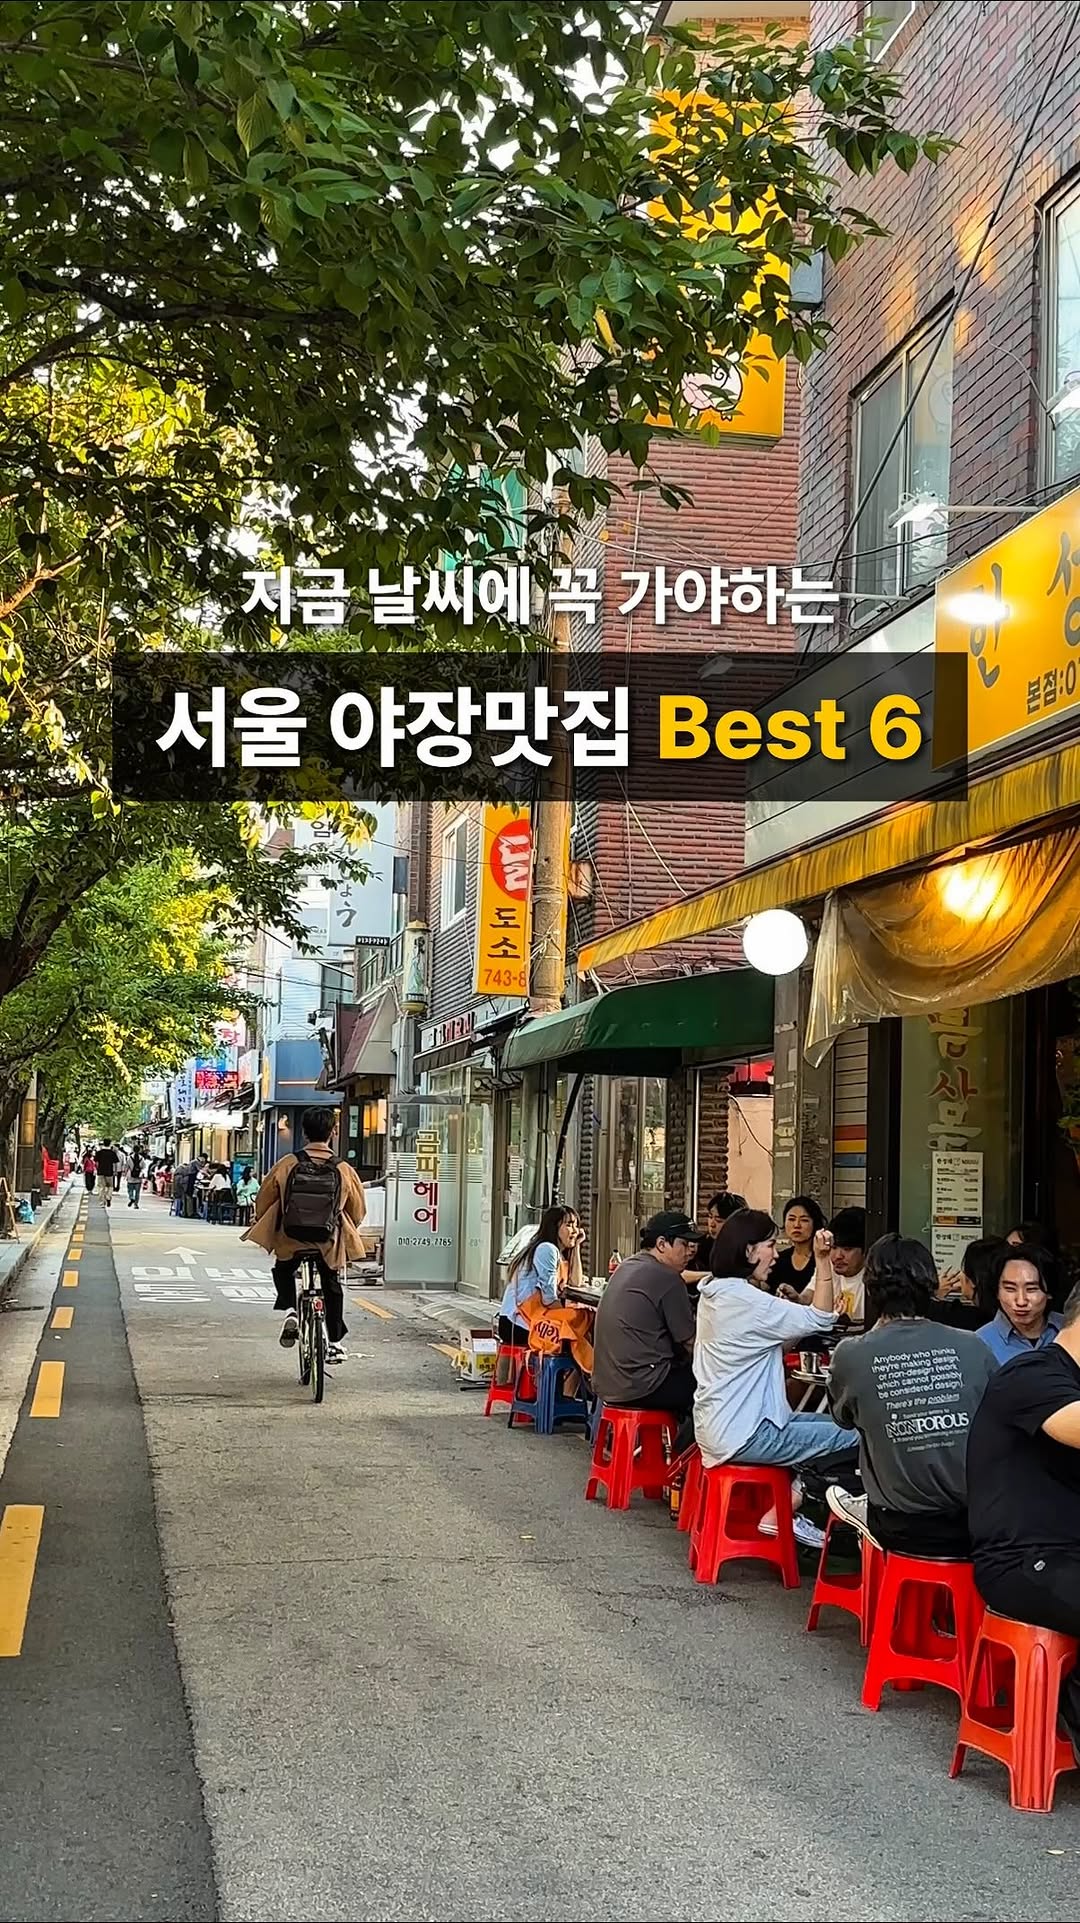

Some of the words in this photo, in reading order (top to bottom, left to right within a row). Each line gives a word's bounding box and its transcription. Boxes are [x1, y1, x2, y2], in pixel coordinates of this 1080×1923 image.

[1026, 657, 1080, 715] 본점:0
[873, 1352, 912, 1364] Anybody
[912, 1351, 930, 1359] who
[931, 1347, 956, 1356] thinks
[871, 1363, 900, 1373] they're
[900, 1358, 931, 1368] making
[876, 1380, 900, 1390] which
[901, 1376, 930, 1386] cannot
[930, 1371, 962, 1383] possibly
[878, 1373, 887, 1381] or
[888, 1367, 935, 1379] non-design
[878, 1391, 889, 1399] be
[889, 1384, 934, 1397] considered
[914, 1397, 927, 1406] the
